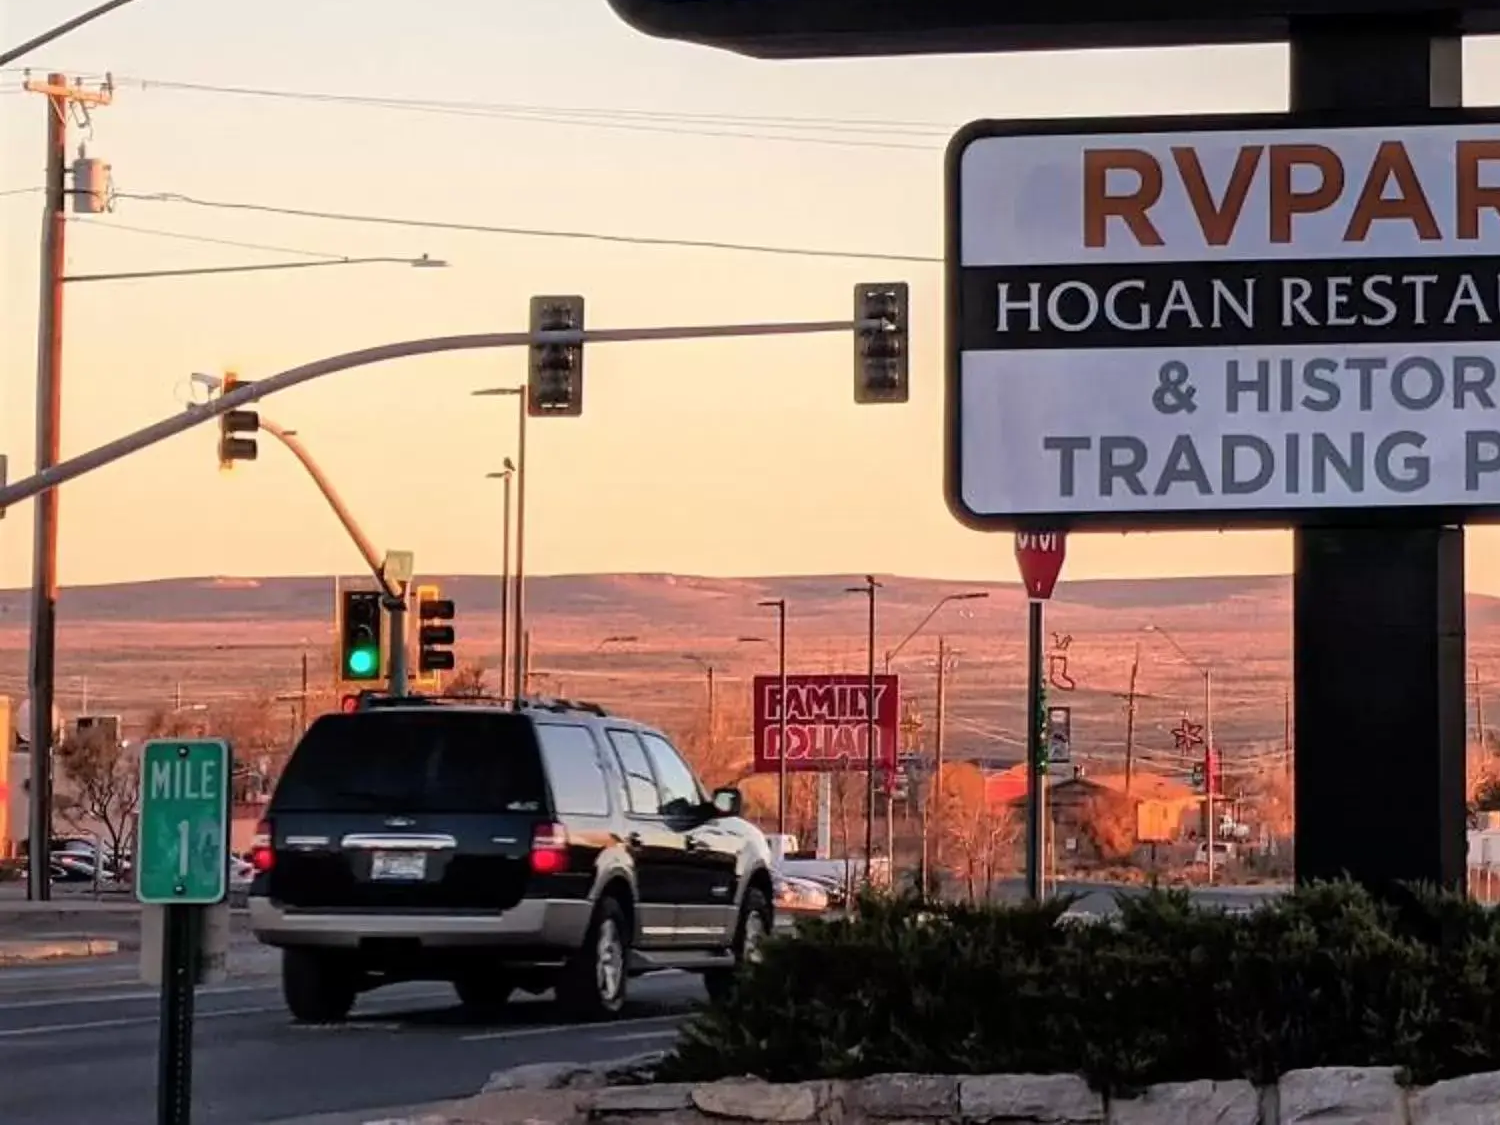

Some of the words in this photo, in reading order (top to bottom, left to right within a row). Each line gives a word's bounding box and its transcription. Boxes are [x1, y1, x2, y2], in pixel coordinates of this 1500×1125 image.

[996, 277, 1256, 332] HOGAN
[1151, 359, 1198, 415] &
[1043, 429, 1431, 498] TRADING
[764, 683, 888, 721] FAMILY
[151, 759, 217, 801] MILE
